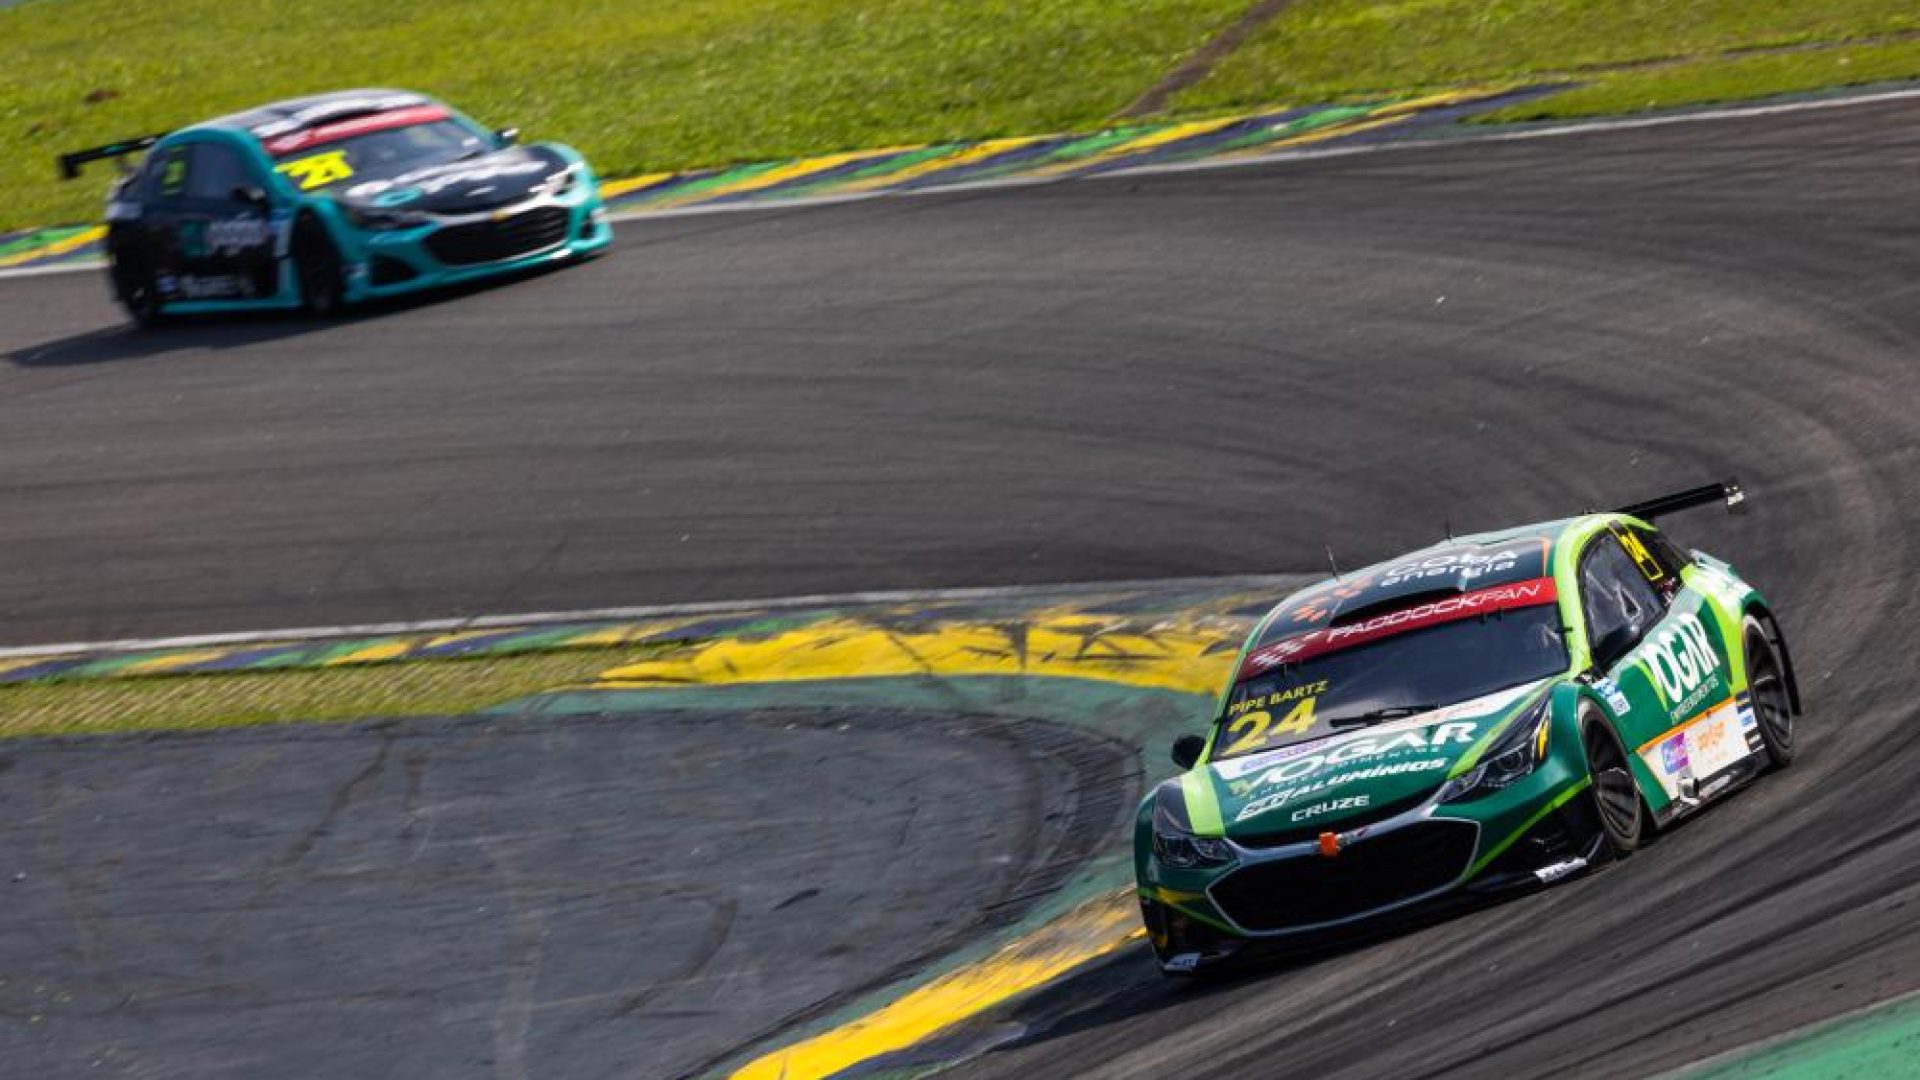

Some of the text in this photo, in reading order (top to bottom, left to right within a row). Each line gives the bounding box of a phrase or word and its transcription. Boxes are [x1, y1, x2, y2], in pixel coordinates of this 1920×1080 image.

[1327, 584, 1541, 643] PADDOCKFAN
[1229, 679, 1329, 716] PIPE BARTZ
[1221, 696, 1318, 757] 24
[1291, 794, 1369, 822] CRUZE
